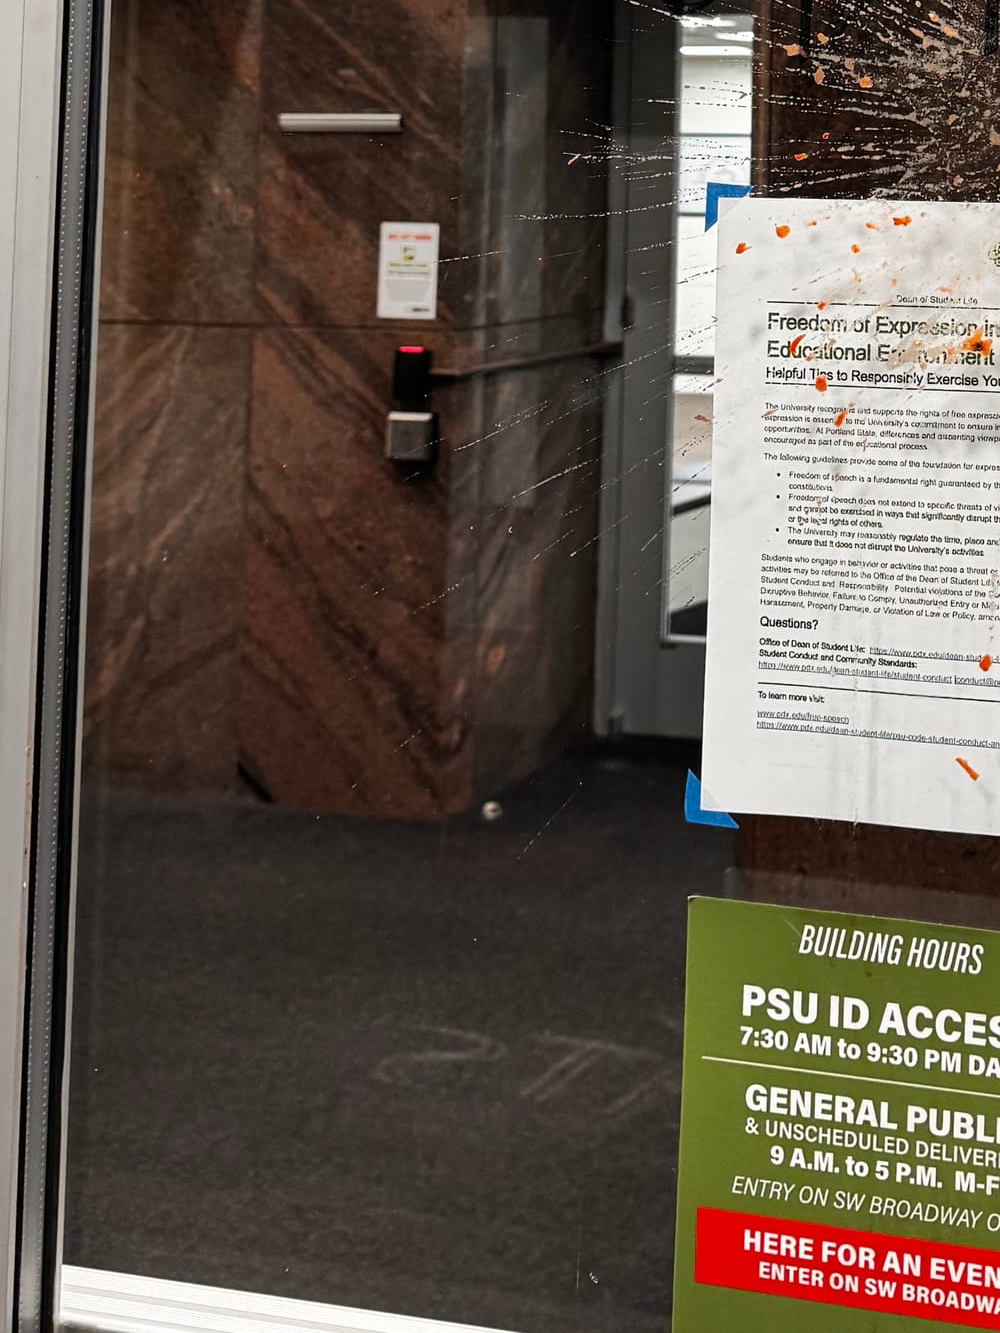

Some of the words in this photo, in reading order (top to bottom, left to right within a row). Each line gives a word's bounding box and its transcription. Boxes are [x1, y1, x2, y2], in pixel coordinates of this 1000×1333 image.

[767, 312, 847, 332] Freedom
[853, 315, 870, 333] of
[984, 319, 1000, 337] in
[766, 366, 806, 381] Helpful
[836, 369, 848, 381] to
[851, 369, 922, 386] Responsibly
[927, 373, 978, 387] Exercise
[759, 615, 819, 631] Questions?
[798, 924, 904, 965] BUILDING
[906, 937, 984, 975] HOURS
[742, 984, 818, 1025] PSU
[829, 994, 870, 1030] ID
[740, 1025, 789, 1051] 7:30
[793, 1032, 832, 1057] AM
[836, 1038, 862, 1060] to
[866, 1042, 918, 1068] 9:30
[924, 1048, 962, 1074] PM
[745, 1083, 898, 1130] GENERAL
[744, 1116, 759, 1135] &
[765, 1119, 909, 1155] UNSCHEDULED
[770, 1145, 785, 1166] 9
[789, 1147, 840, 1174] A.M.
[844, 1155, 869, 1178] to
[875, 1160, 890, 1181] 5
[895, 1162, 943, 1189] P.M.
[954, 1170, 1000, 1196] M-F
[731, 1175, 796, 1201] ENTRY
[799, 1185, 829, 1207] ON
[833, 1190, 866, 1212] SW
[869, 1195, 983, 1229] BROADWAY
[743, 1229, 814, 1260] HERE
[821, 1240, 876, 1270] FOR
[882, 1250, 921, 1277] AN
[759, 1261, 824, 1288] ENTER
[829, 1272, 859, 1293] ON
[864, 1278, 897, 1299] SW
